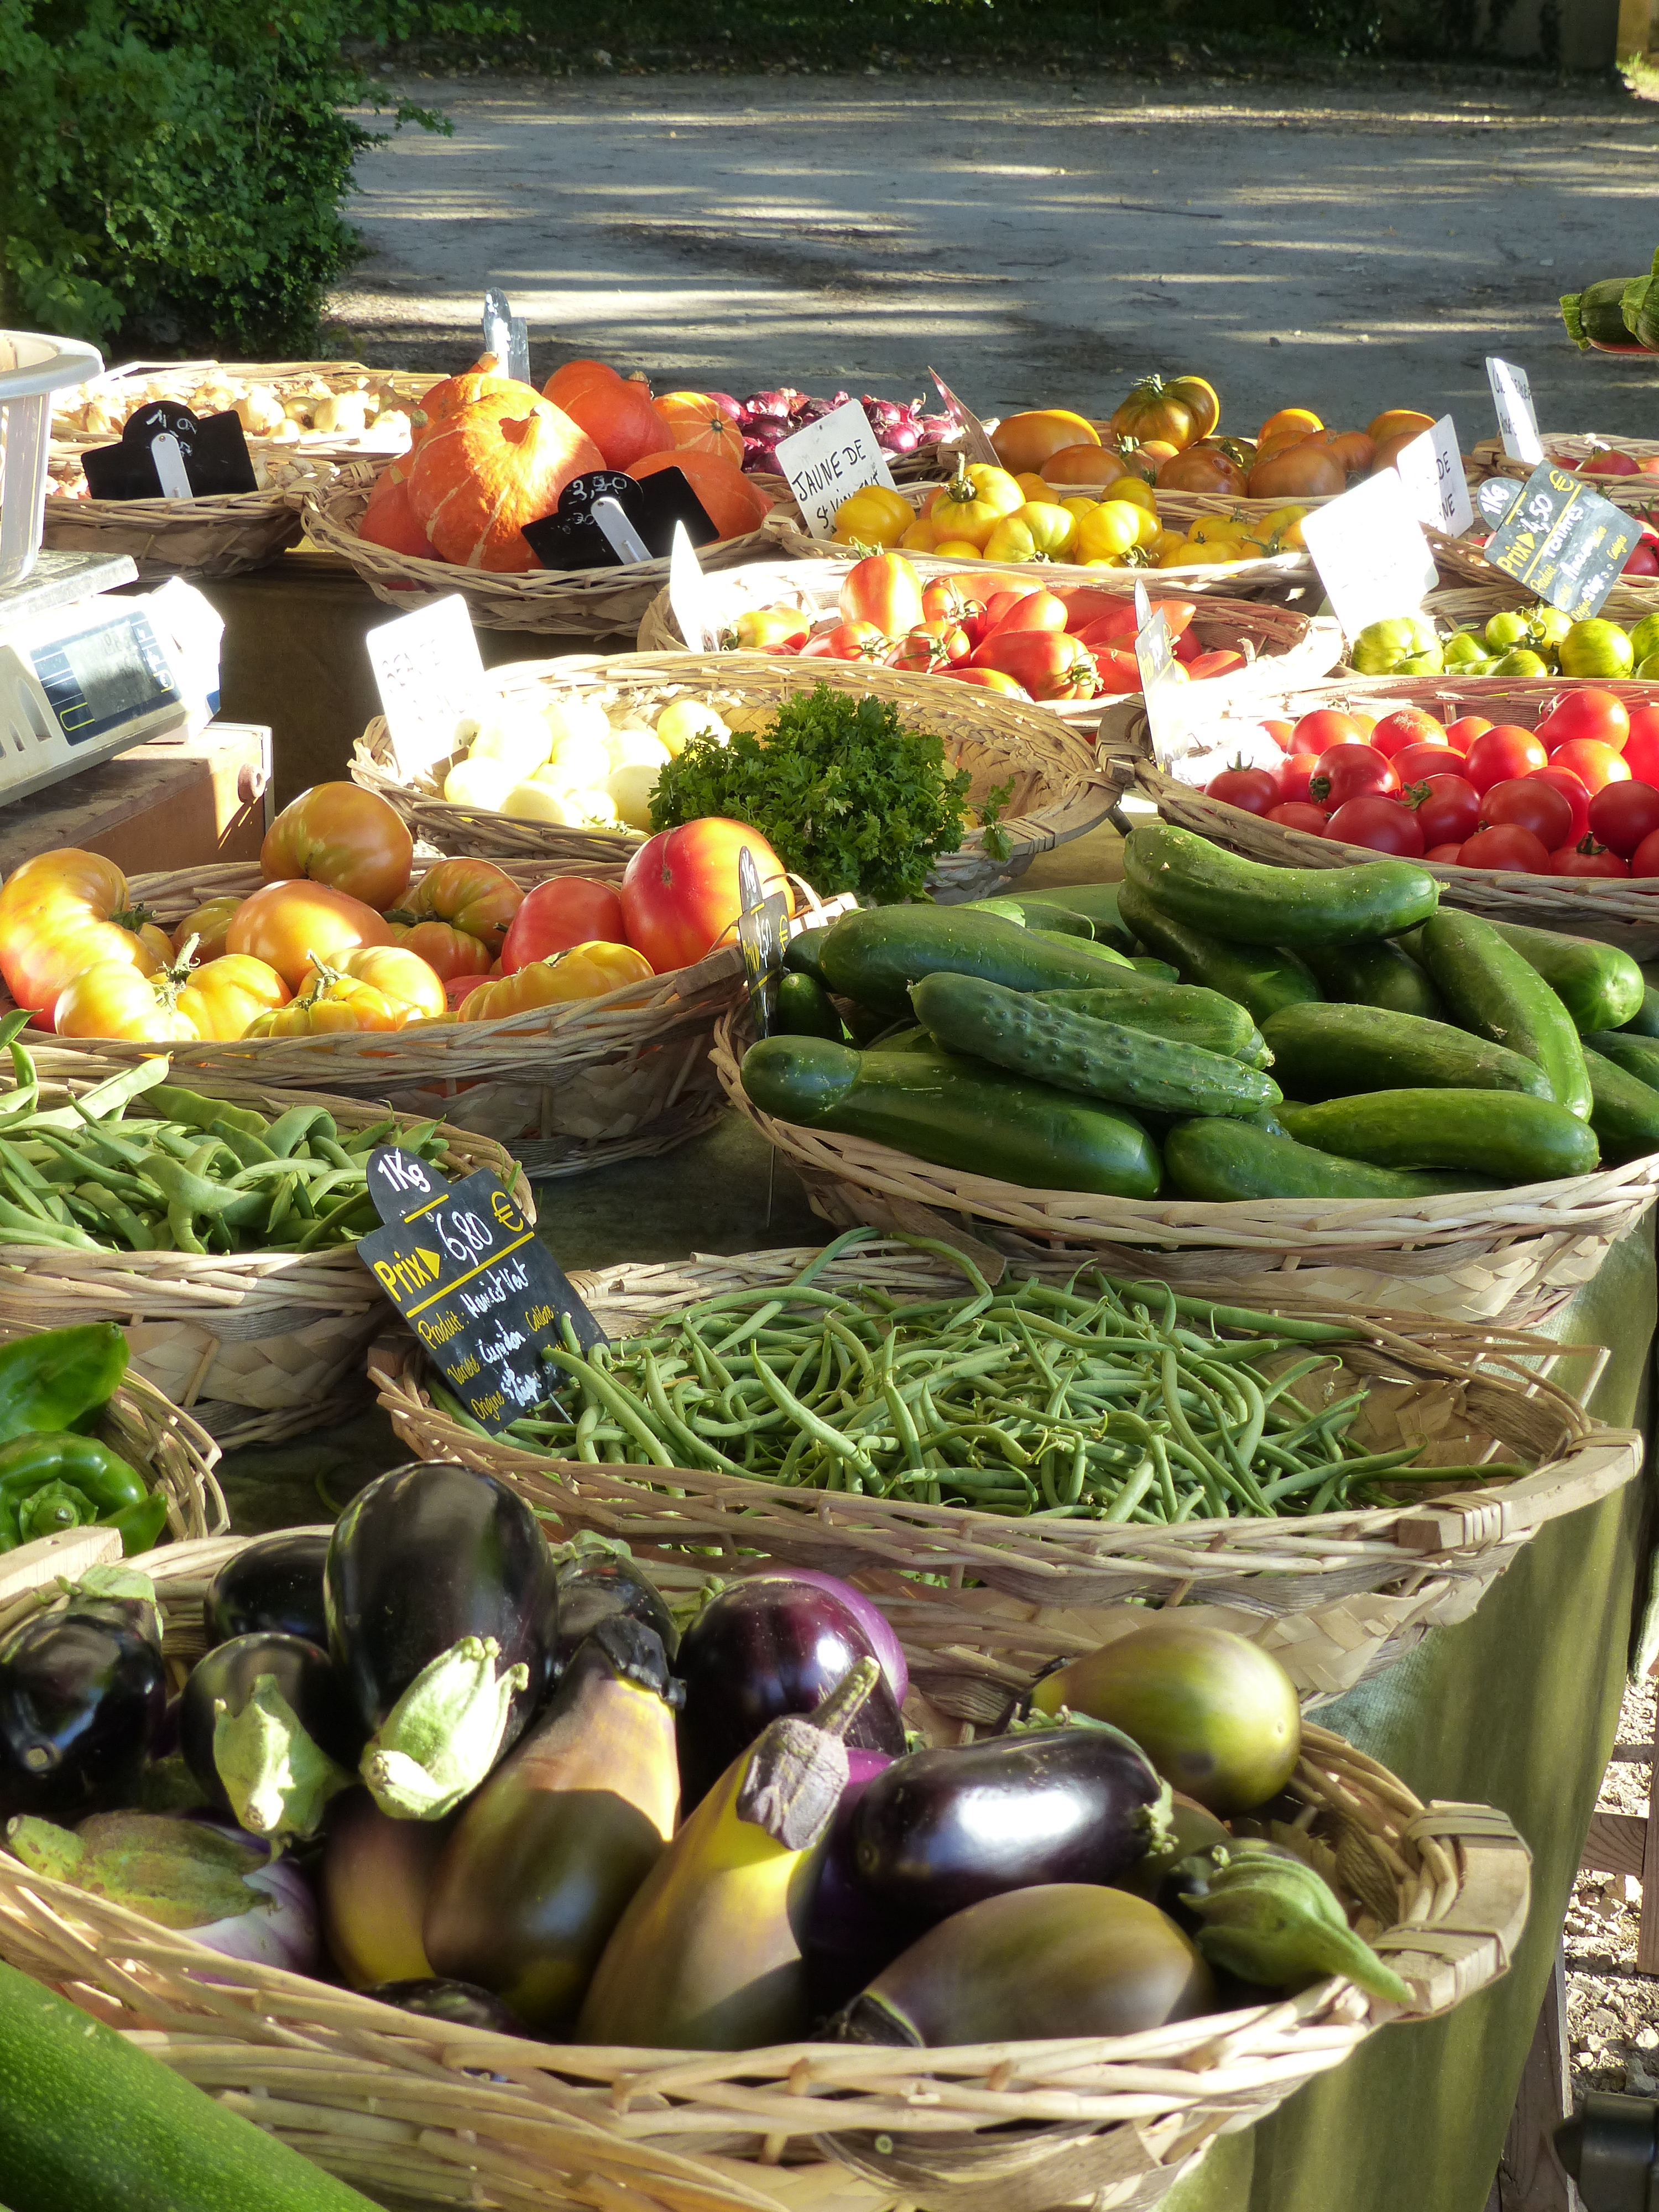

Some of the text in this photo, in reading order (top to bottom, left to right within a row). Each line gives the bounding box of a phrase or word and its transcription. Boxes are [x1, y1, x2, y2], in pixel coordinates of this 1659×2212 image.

[791, 451, 843, 502] JAUNE
[842, 439, 867, 466] DE
[1436, 451, 1451, 481] DE
[1479, 483, 1510, 515] 1Kg
[1496, 470, 1575, 577] Prix 4,50 €
[377, 1148, 432, 1193] 1Kg
[373, 1191, 524, 1302] Prix 6,80 €
